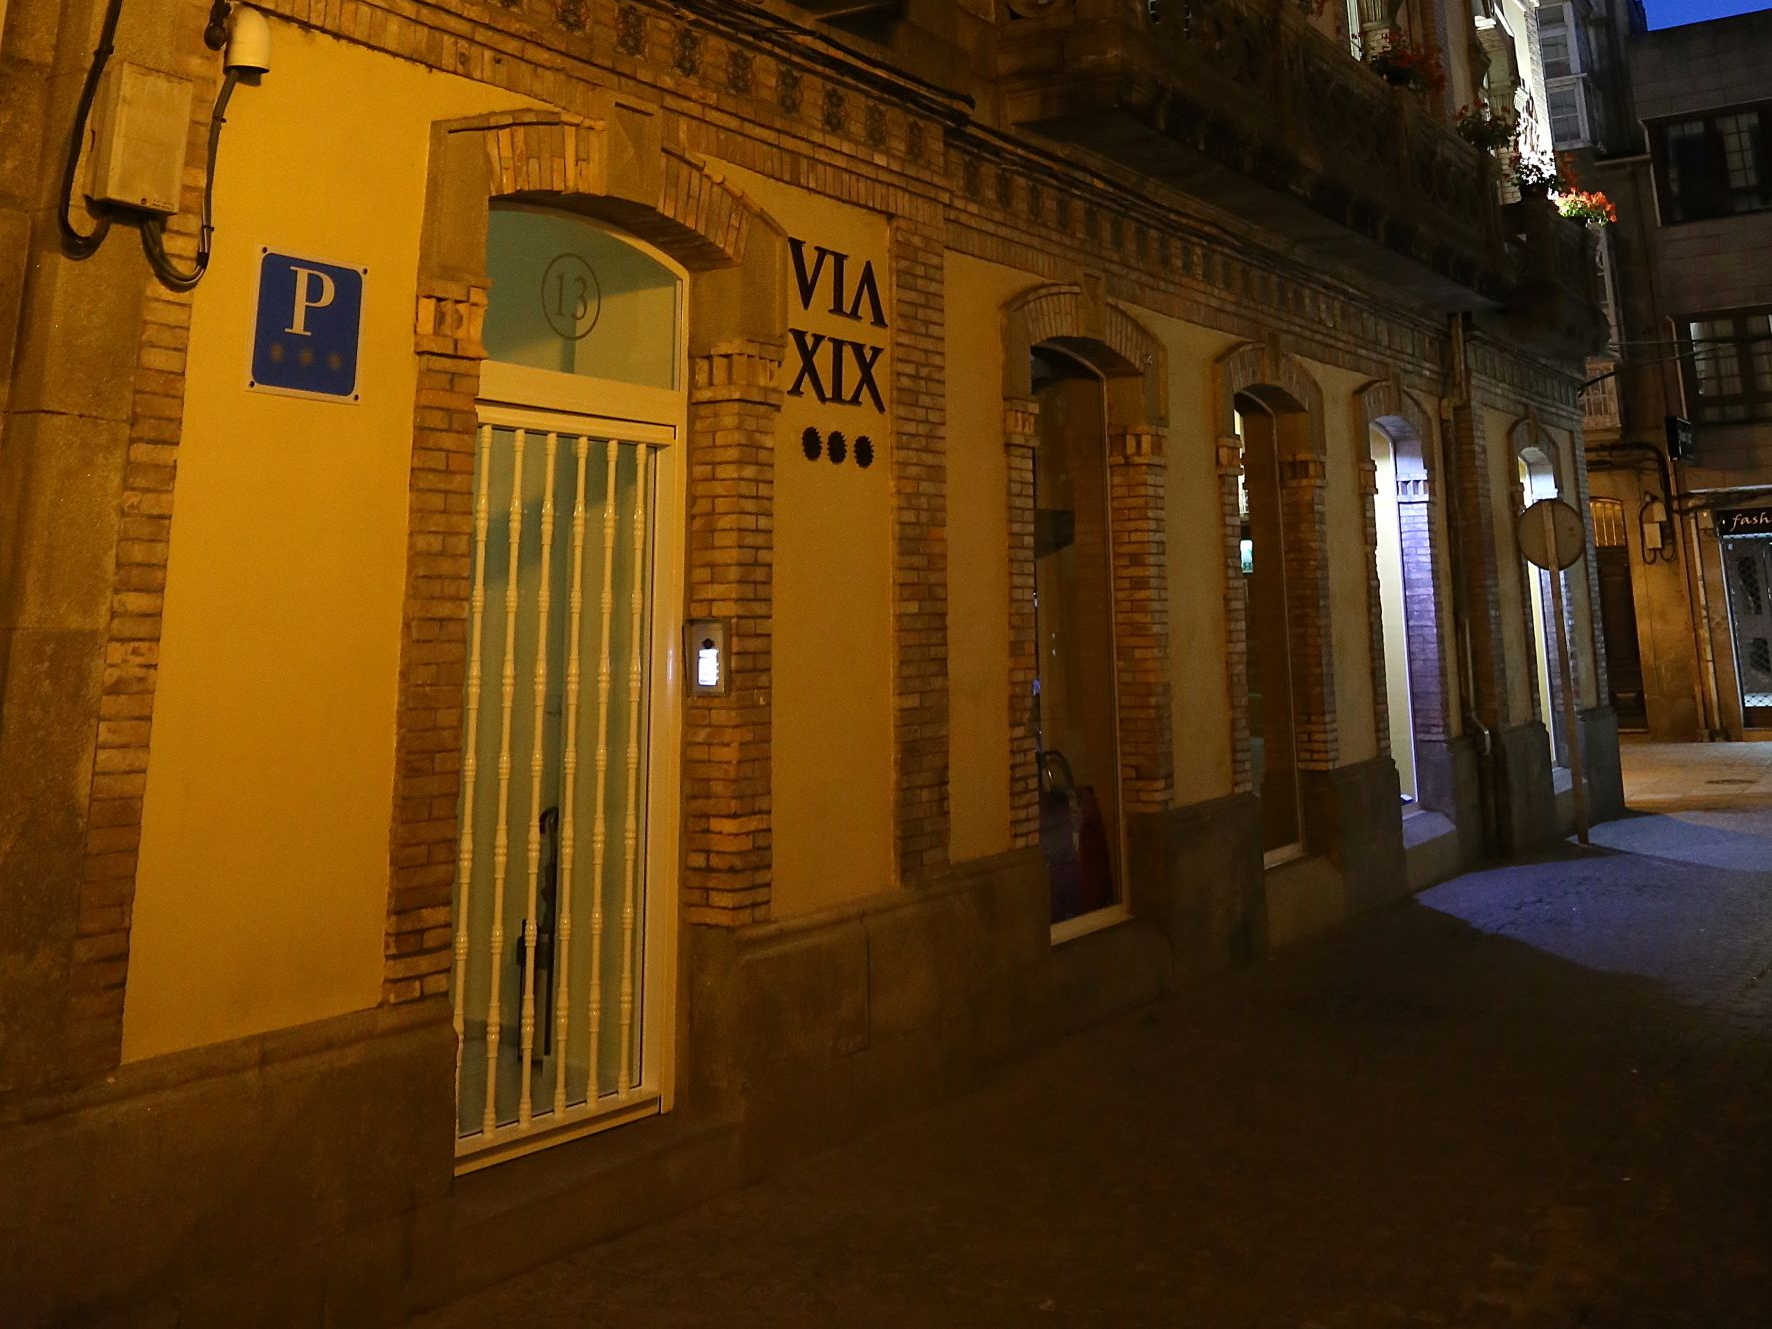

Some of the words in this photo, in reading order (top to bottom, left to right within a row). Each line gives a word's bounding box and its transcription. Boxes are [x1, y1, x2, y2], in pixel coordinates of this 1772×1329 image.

[284, 265, 336, 337] P
[555, 272, 588, 320] 13
[788, 237, 888, 328] VIA
[787, 328, 885, 414] XIX
